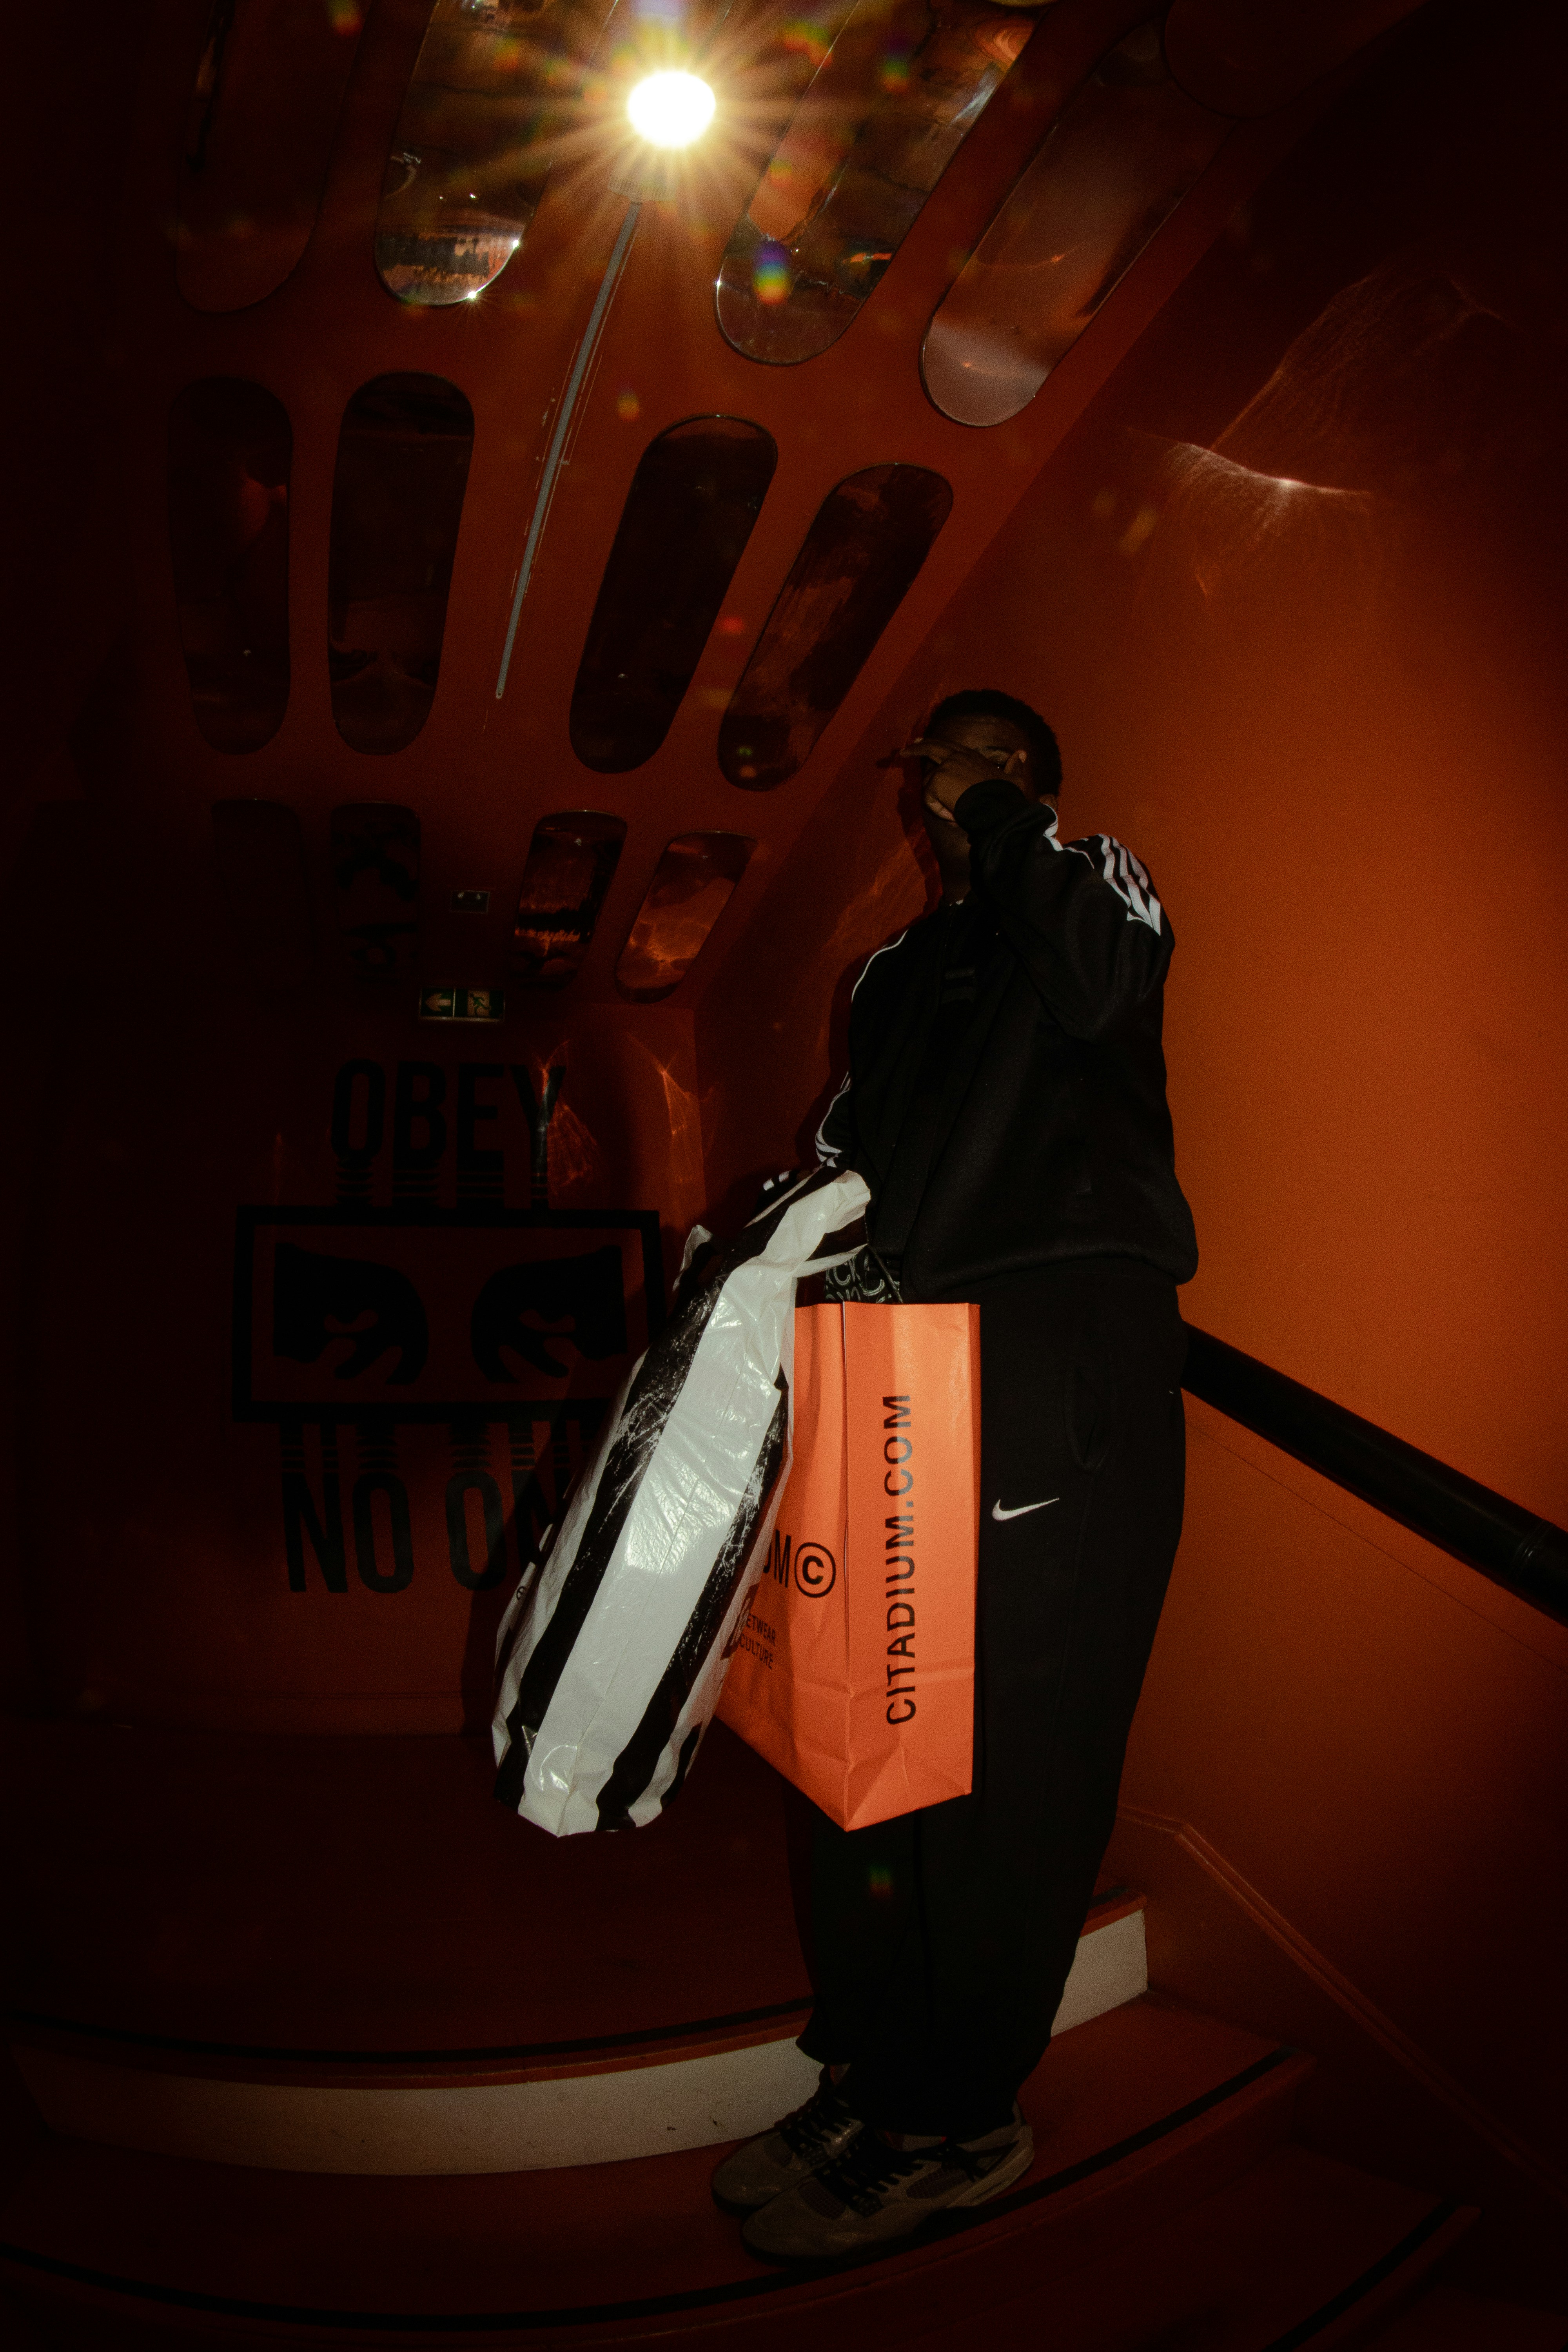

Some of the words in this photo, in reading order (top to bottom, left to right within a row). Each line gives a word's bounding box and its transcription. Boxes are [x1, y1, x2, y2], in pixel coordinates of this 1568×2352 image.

[331, 1060, 566, 1172] OBEY
[282, 1472, 414, 1593] NO
[446, 1470, 570, 1590] ON
[882, 1395, 916, 1725] CITADIUM.COM
[740, 1633, 773, 1670] CULTURE
[746, 1613, 776, 1646] ETWEAR
